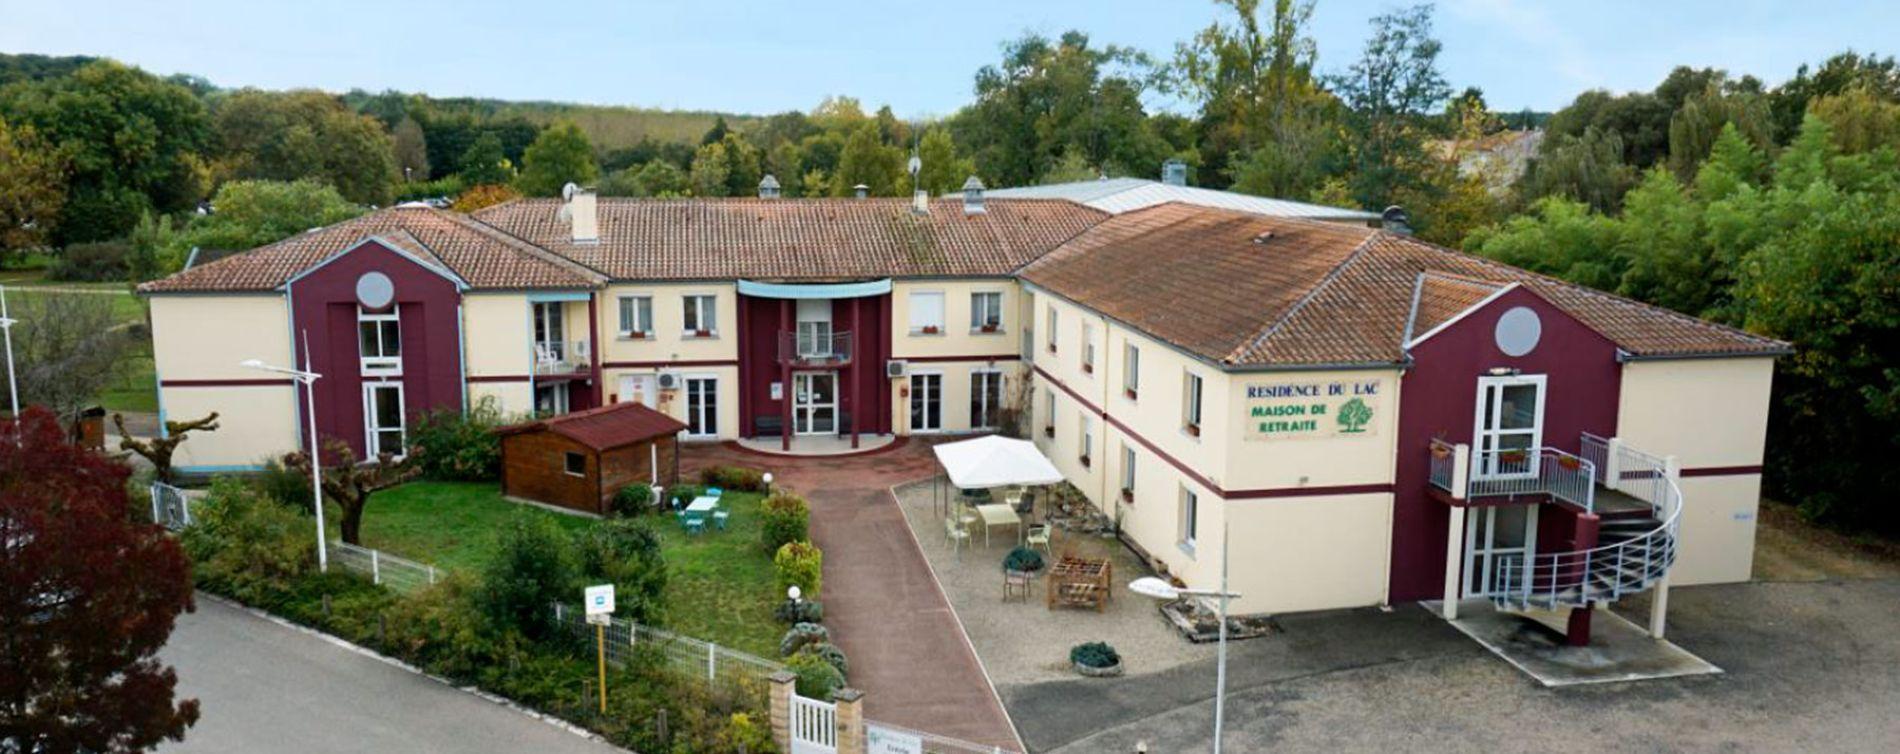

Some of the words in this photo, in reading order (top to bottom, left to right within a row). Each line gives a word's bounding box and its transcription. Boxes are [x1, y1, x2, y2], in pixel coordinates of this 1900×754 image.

[1247, 385, 1320, 398] RESIDENCE
[1328, 383, 1345, 395] DU
[1354, 382, 1379, 395] LAC
[1251, 405, 1306, 417] MAISON
[1310, 404, 1327, 415] DE
[1259, 420, 1317, 432] RETRAITE
